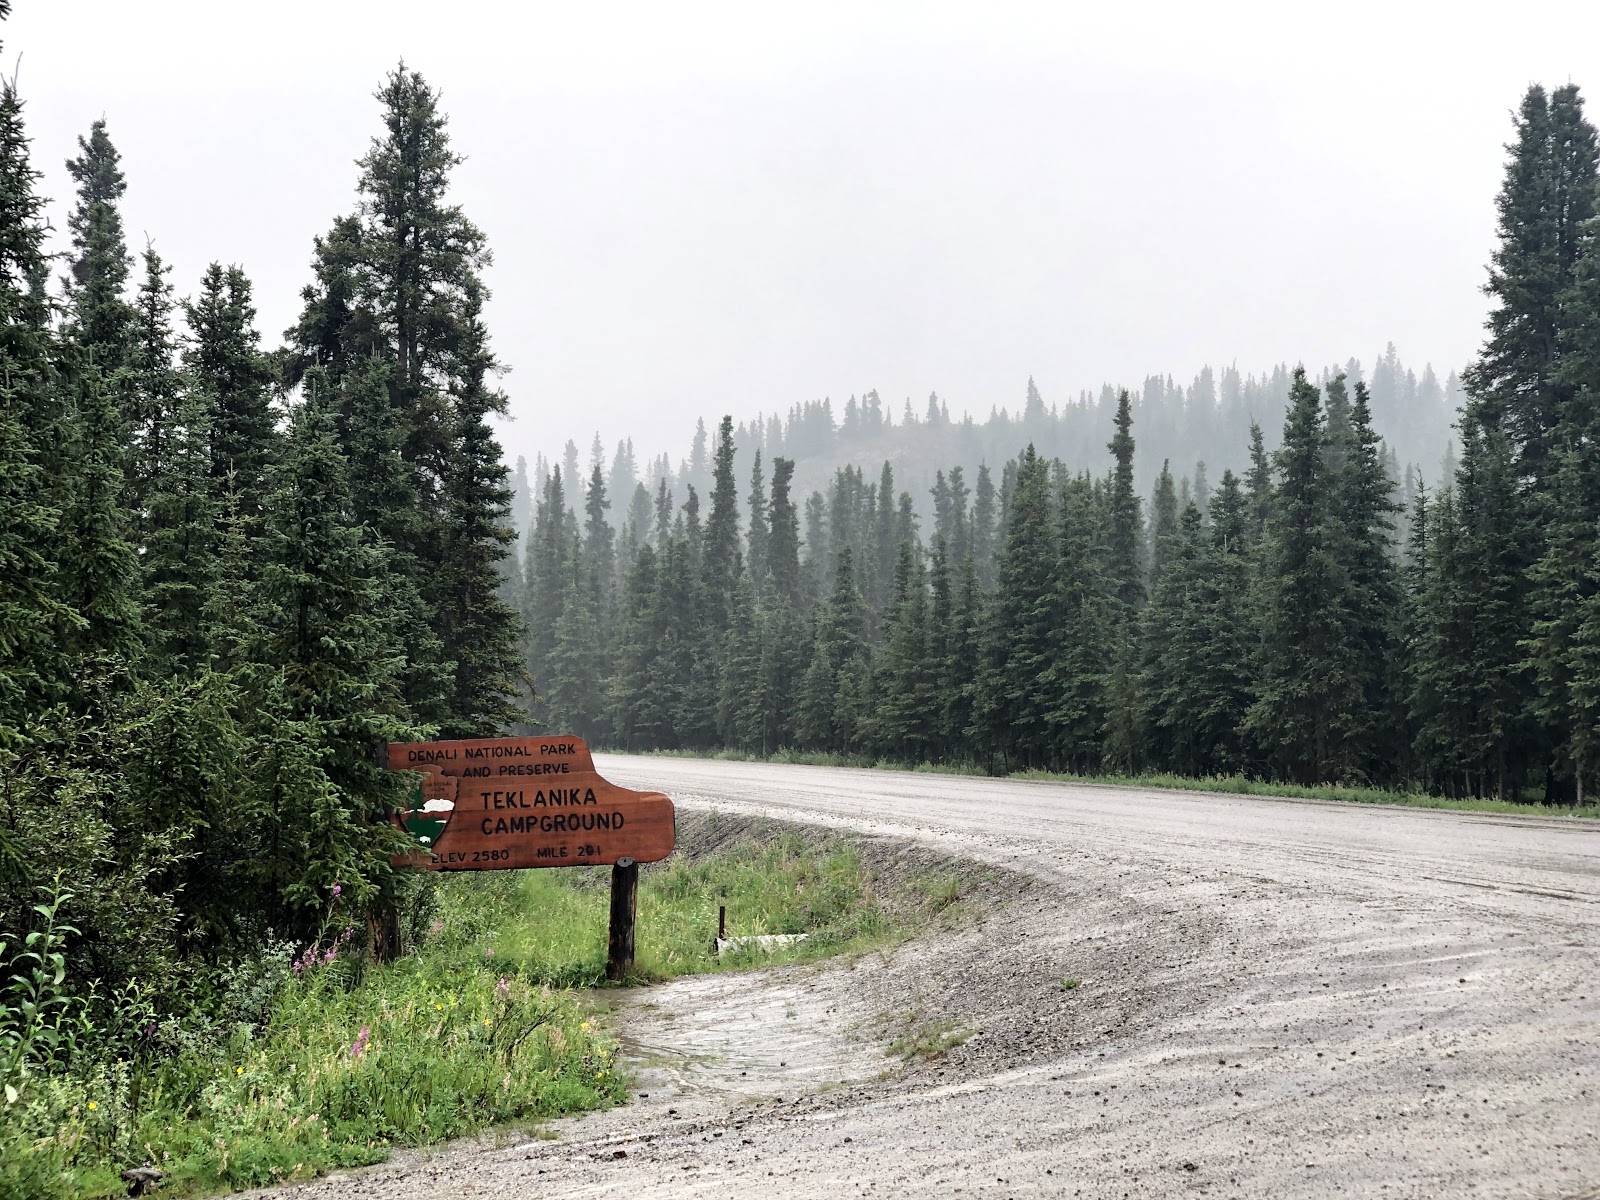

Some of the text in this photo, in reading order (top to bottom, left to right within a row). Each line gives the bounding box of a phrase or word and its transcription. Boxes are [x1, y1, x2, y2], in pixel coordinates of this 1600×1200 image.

[408, 743, 576, 762] DENALI NATIONAL PARK
[462, 763, 570, 778] AND PRESERVE
[480, 788, 597, 810] TEKLANIKA
[482, 812, 624, 834] CAMPGROUND
[472, 847, 510, 862] 2580
[537, 847, 568, 858] MILE
